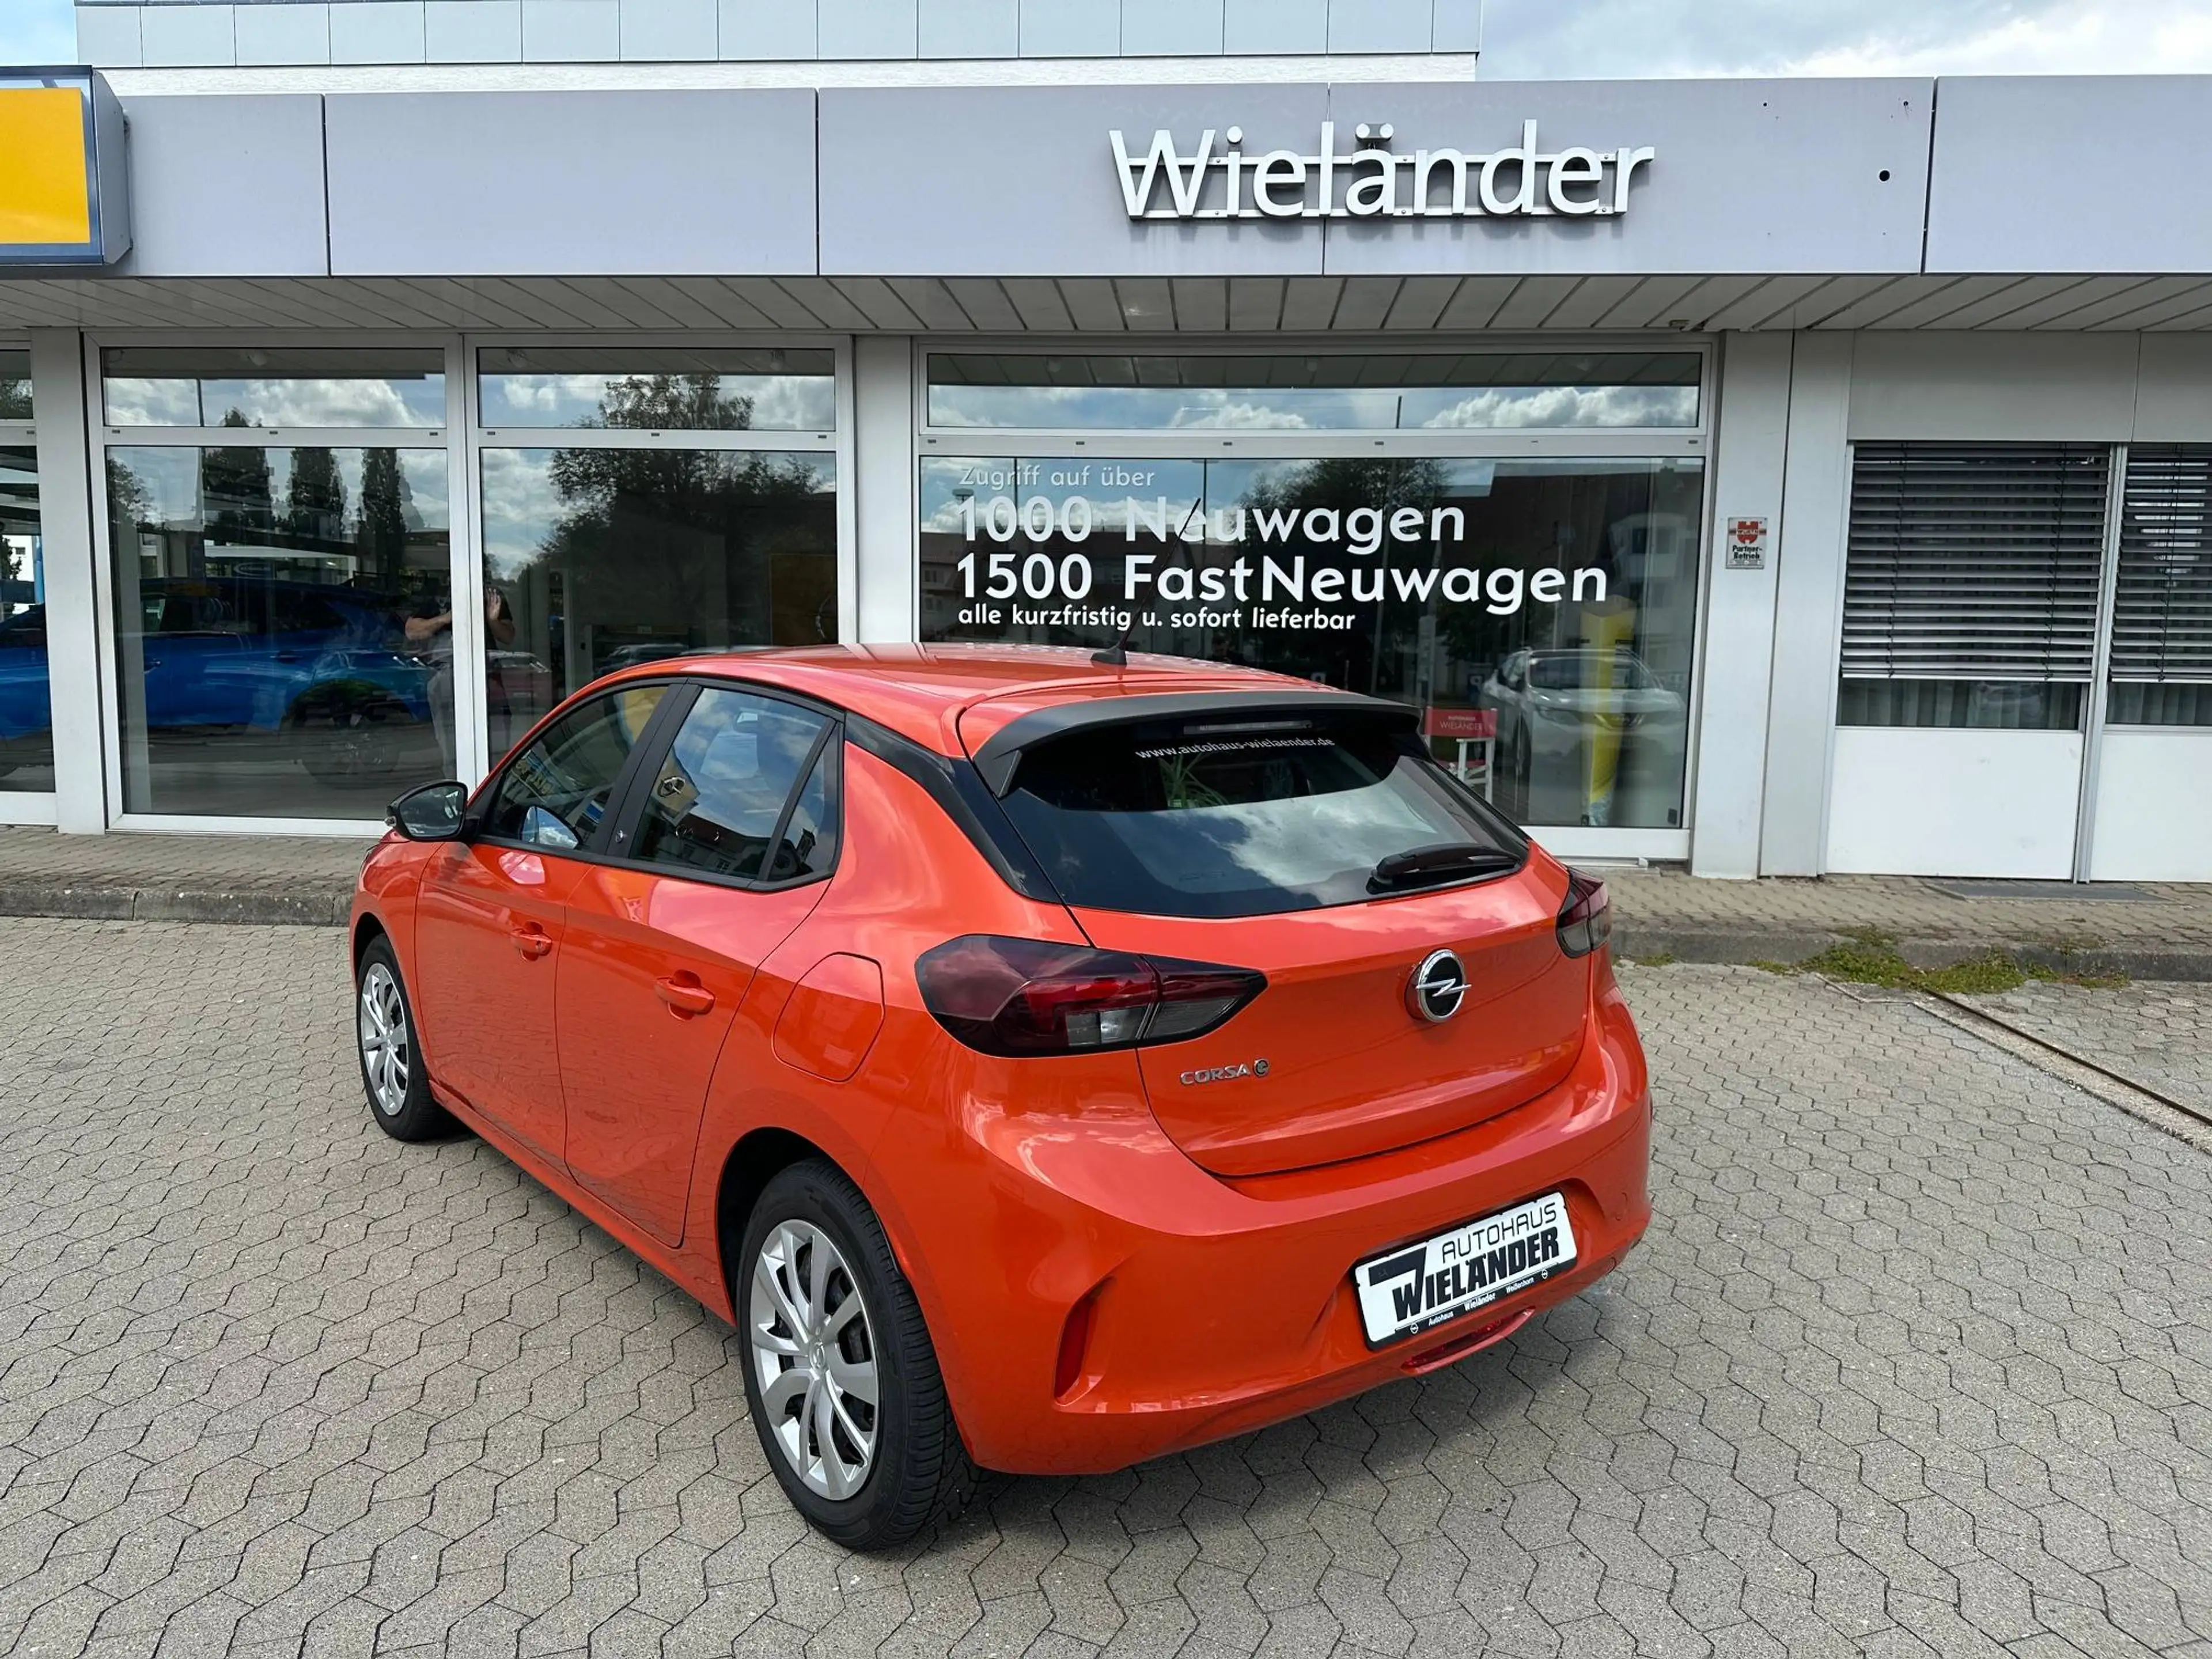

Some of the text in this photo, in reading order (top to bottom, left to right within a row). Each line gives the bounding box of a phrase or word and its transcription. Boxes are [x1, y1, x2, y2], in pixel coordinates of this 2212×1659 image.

[1109, 119, 1654, 218] Wieländer
[959, 467, 1155, 490] Zugriff auf über
[958, 495, 1465, 555] 1000 Neuwagen
[957, 552, 1607, 615] 1500 FastNeuwagen
[958, 604, 1355, 631] alle kurzfristig u. sofort lieferbar
[1135, 737, 1335, 758] www.autohaus-wielaender.de
[1180, 1063, 1250, 1085] CORSA
[1441, 1202, 1556, 1263] AUTOHAUS
[1392, 1226, 1559, 1322] WIELÄNDER
[1463, 1293, 1496, 1312] Wieländer
